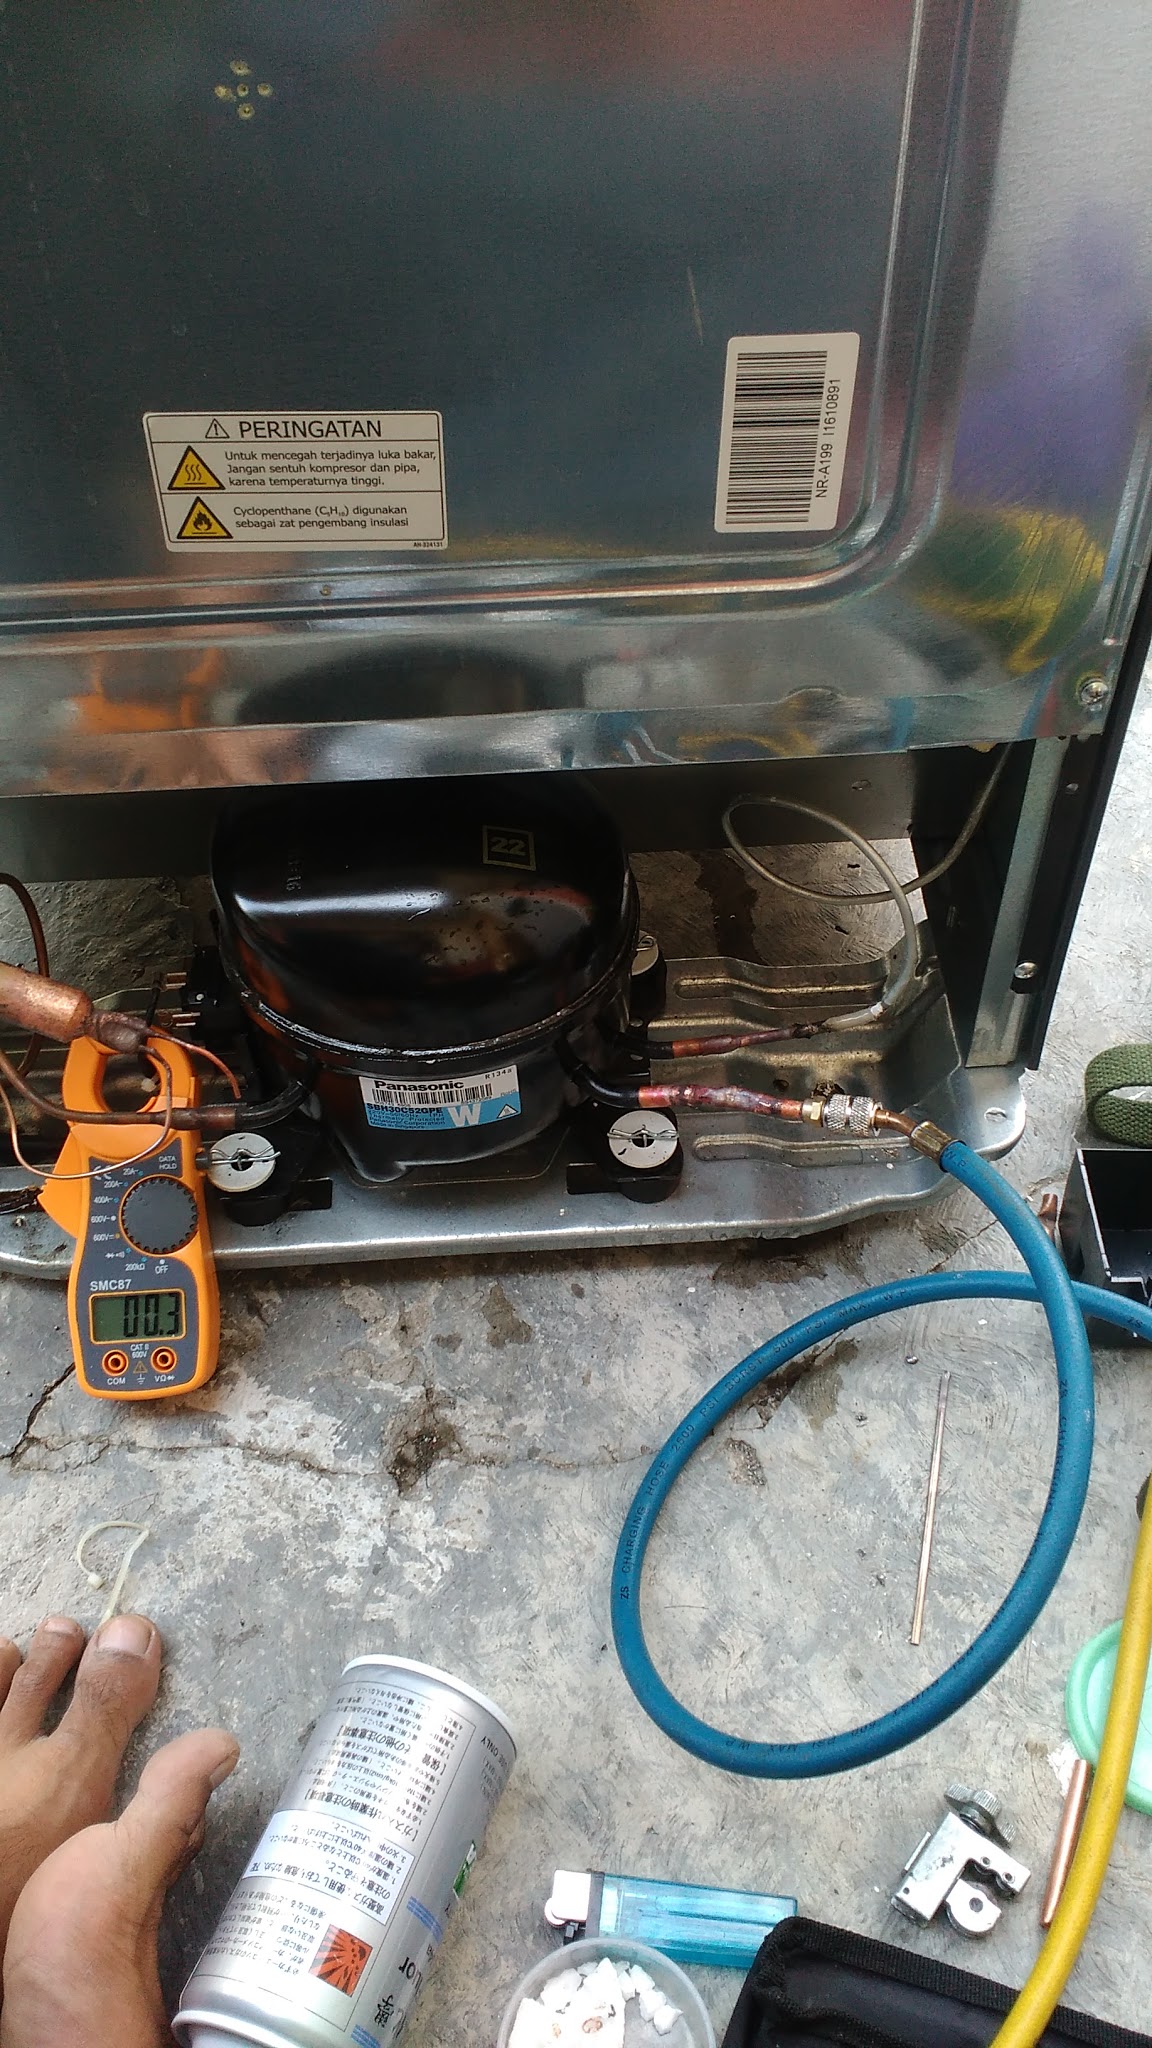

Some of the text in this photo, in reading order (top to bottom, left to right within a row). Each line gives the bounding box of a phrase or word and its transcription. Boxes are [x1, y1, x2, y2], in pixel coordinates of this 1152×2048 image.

[239, 420, 382, 438] PERINGATAN
[225, 450, 437, 463] Untuk mencegah terjadinya luka bakar,
[227, 463, 420, 476] Jangan sentuh kompresor dan pipa,
[815, 443, 833, 498] NR-A199
[229, 476, 385, 488] karena temperaturnya tinggi.
[233, 506, 311, 518] Cyclopenthane
[353, 505, 407, 517] digunakan
[236, 518, 409, 530] sebagai zat pengembang insulasi
[490, 835, 527, 857] 22
[374, 1069, 512, 1092] Panasonic R134a
[447, 1103, 481, 1127] W
[159, 1155, 176, 1163] DATA
[155, 1265, 169, 1274] OFF
[89, 1278, 132, 1291] SMC87
[123, 1292, 181, 1337] 00.3
[804, 1319, 827, 1334] PSI
[107, 1377, 126, 1385] COM
[724, 1357, 763, 1392] BURST
[700, 1395, 719, 1418] PSI
[646, 1462, 669, 1497] HOSE
[622, 1505, 647, 1574] CHARGING
[620, 1585, 629, 1600] ZS
[480, 1735, 498, 1757] ONLY
